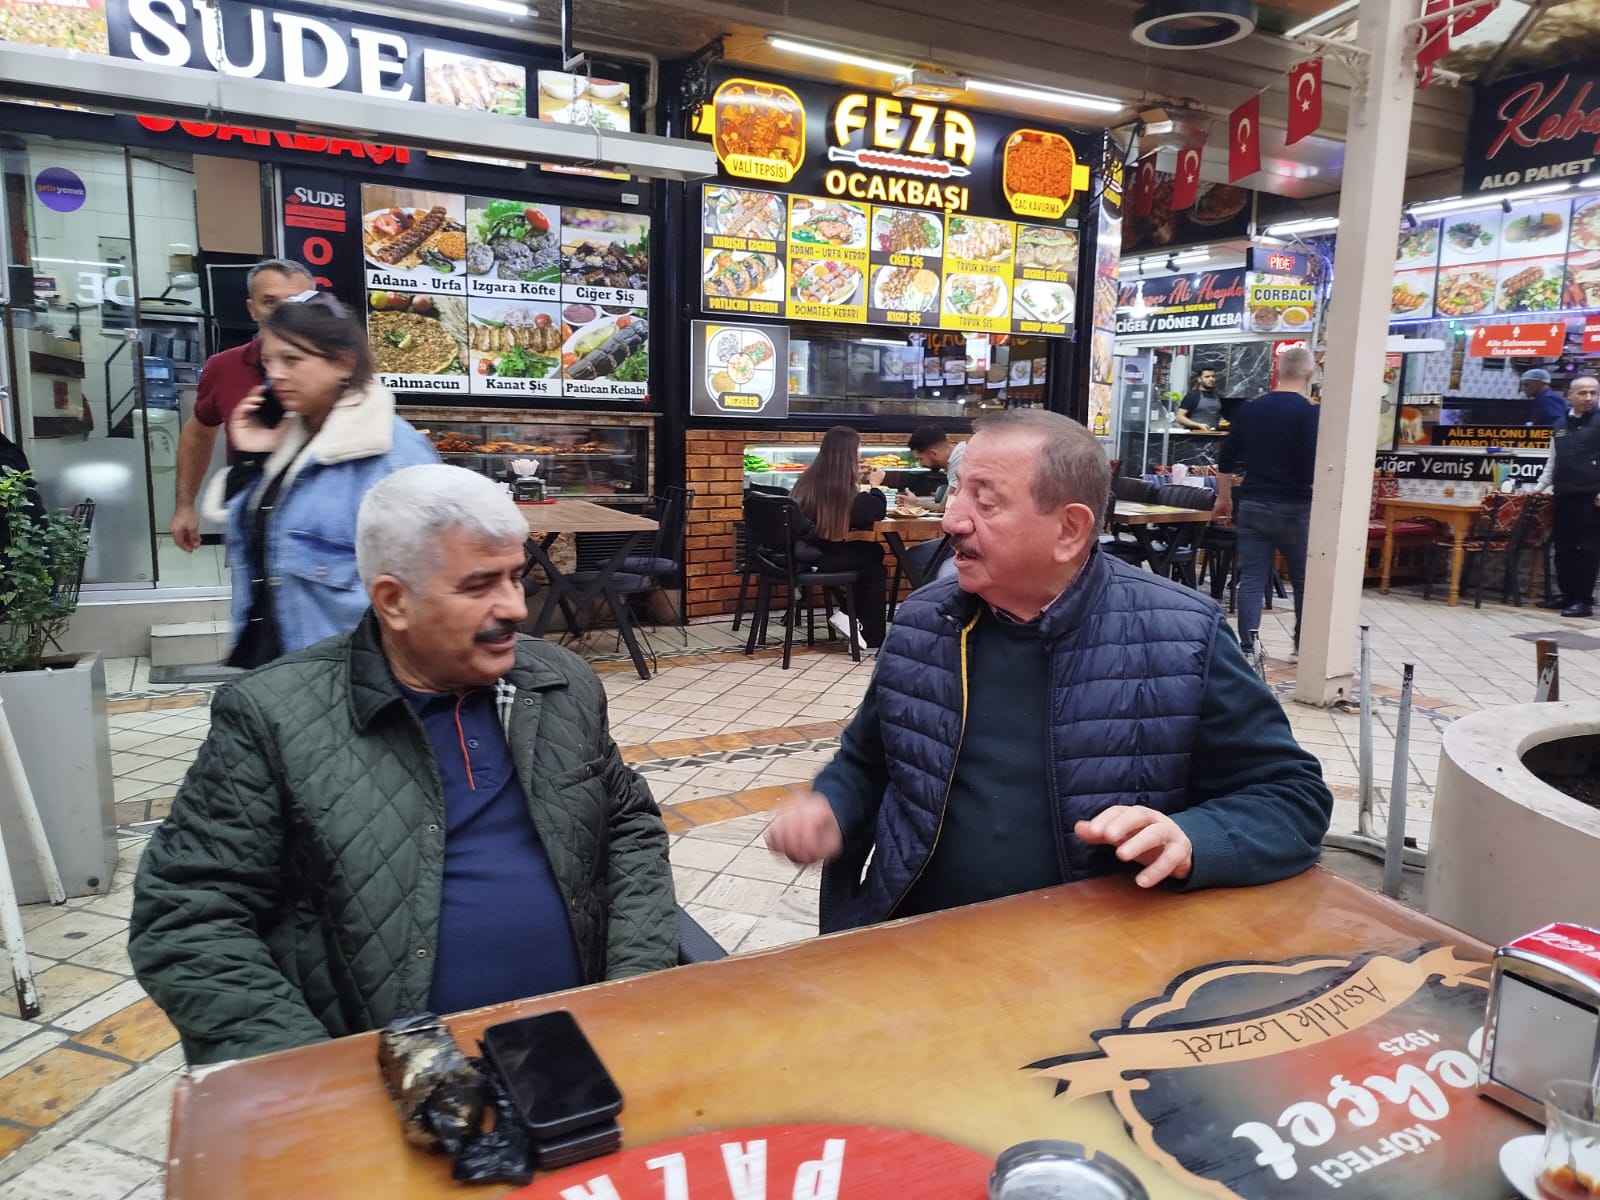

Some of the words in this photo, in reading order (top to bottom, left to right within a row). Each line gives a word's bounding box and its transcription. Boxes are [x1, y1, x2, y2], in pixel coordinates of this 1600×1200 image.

[129, 0, 413, 101] SUDE
[835, 94, 976, 166] FEZA
[1479, 171, 1521, 190] ALO
[1524, 158, 1596, 183] PAKET
[294, 187, 345, 207] SUDE
[825, 169, 969, 214] OCAKBAŞI
[371, 274, 418, 288] Adana
[431, 278, 462, 291] Urfa
[473, 280, 517, 296] Izgara
[520, 282, 556, 296] Köfte
[576, 286, 612, 302] Ciğer
[615, 287, 635, 304] Şiş
[795, 304, 831, 317] DOMATES
[1158, 315, 1200, 330] DÖNER
[380, 376, 460, 390] Lahmacun
[485, 378, 526, 391] Kanat
[529, 379, 548, 394] Şiş
[566, 383, 609, 395] Patlıcan
[610, 385, 646, 396] Kebabı
[1448, 428, 1475, 438] AİLE
[1477, 429, 1526, 439] SALONU
[1374, 456, 1416, 474] Ciğer
[1421, 457, 1473, 478] Yemiş
[1287, 976, 1387, 1037] Asırlık
[1172, 1018, 1302, 1063] Lezzet
[1378, 1029, 1441, 1057] 1925
[1232, 1026, 1484, 1181] ehçet
[1309, 1123, 1442, 1189] KÖFTECİ
